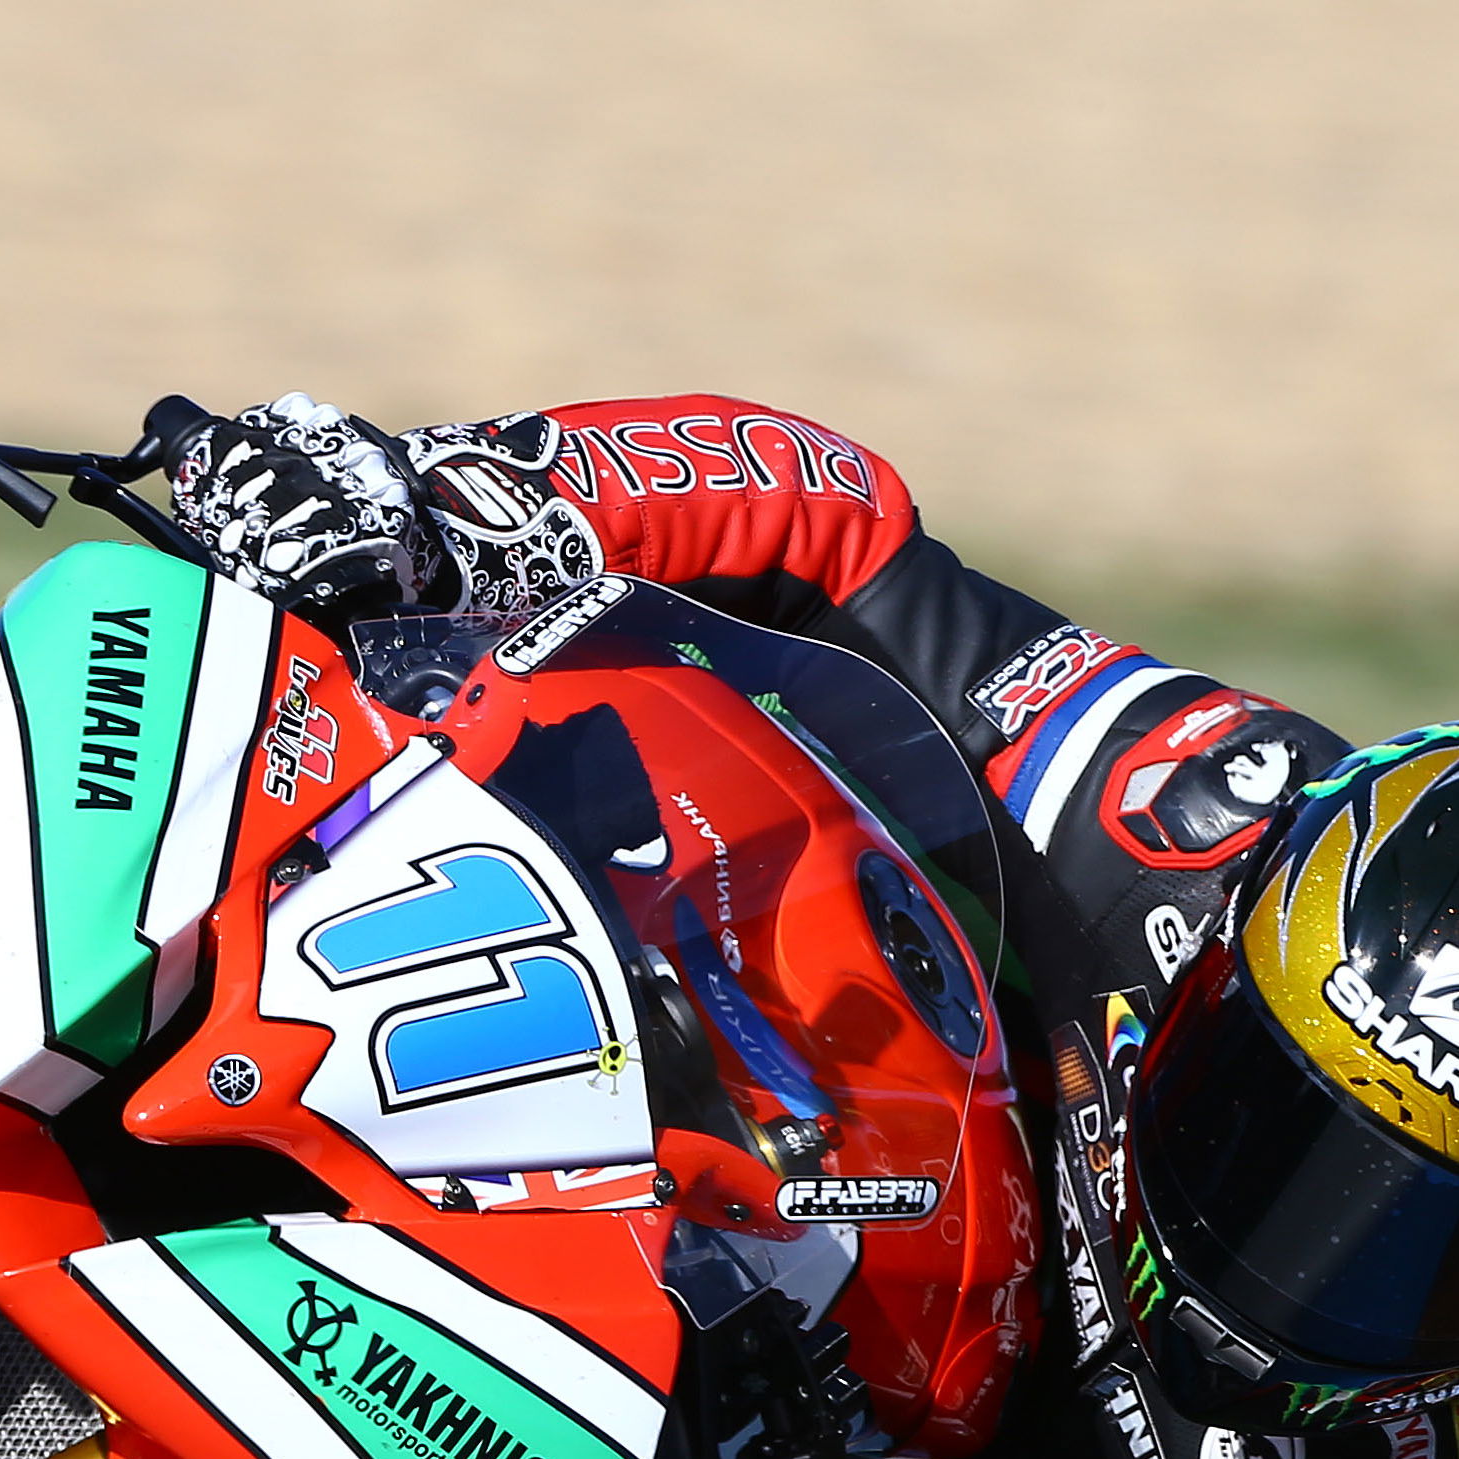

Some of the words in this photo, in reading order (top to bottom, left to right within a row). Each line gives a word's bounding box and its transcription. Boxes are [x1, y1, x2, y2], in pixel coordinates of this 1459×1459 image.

[549, 414, 884, 518] RUSSIA
[74, 607, 152, 811] YAMAHA
[991, 629, 1122, 735] TCX
[298, 842, 620, 1115] 11
